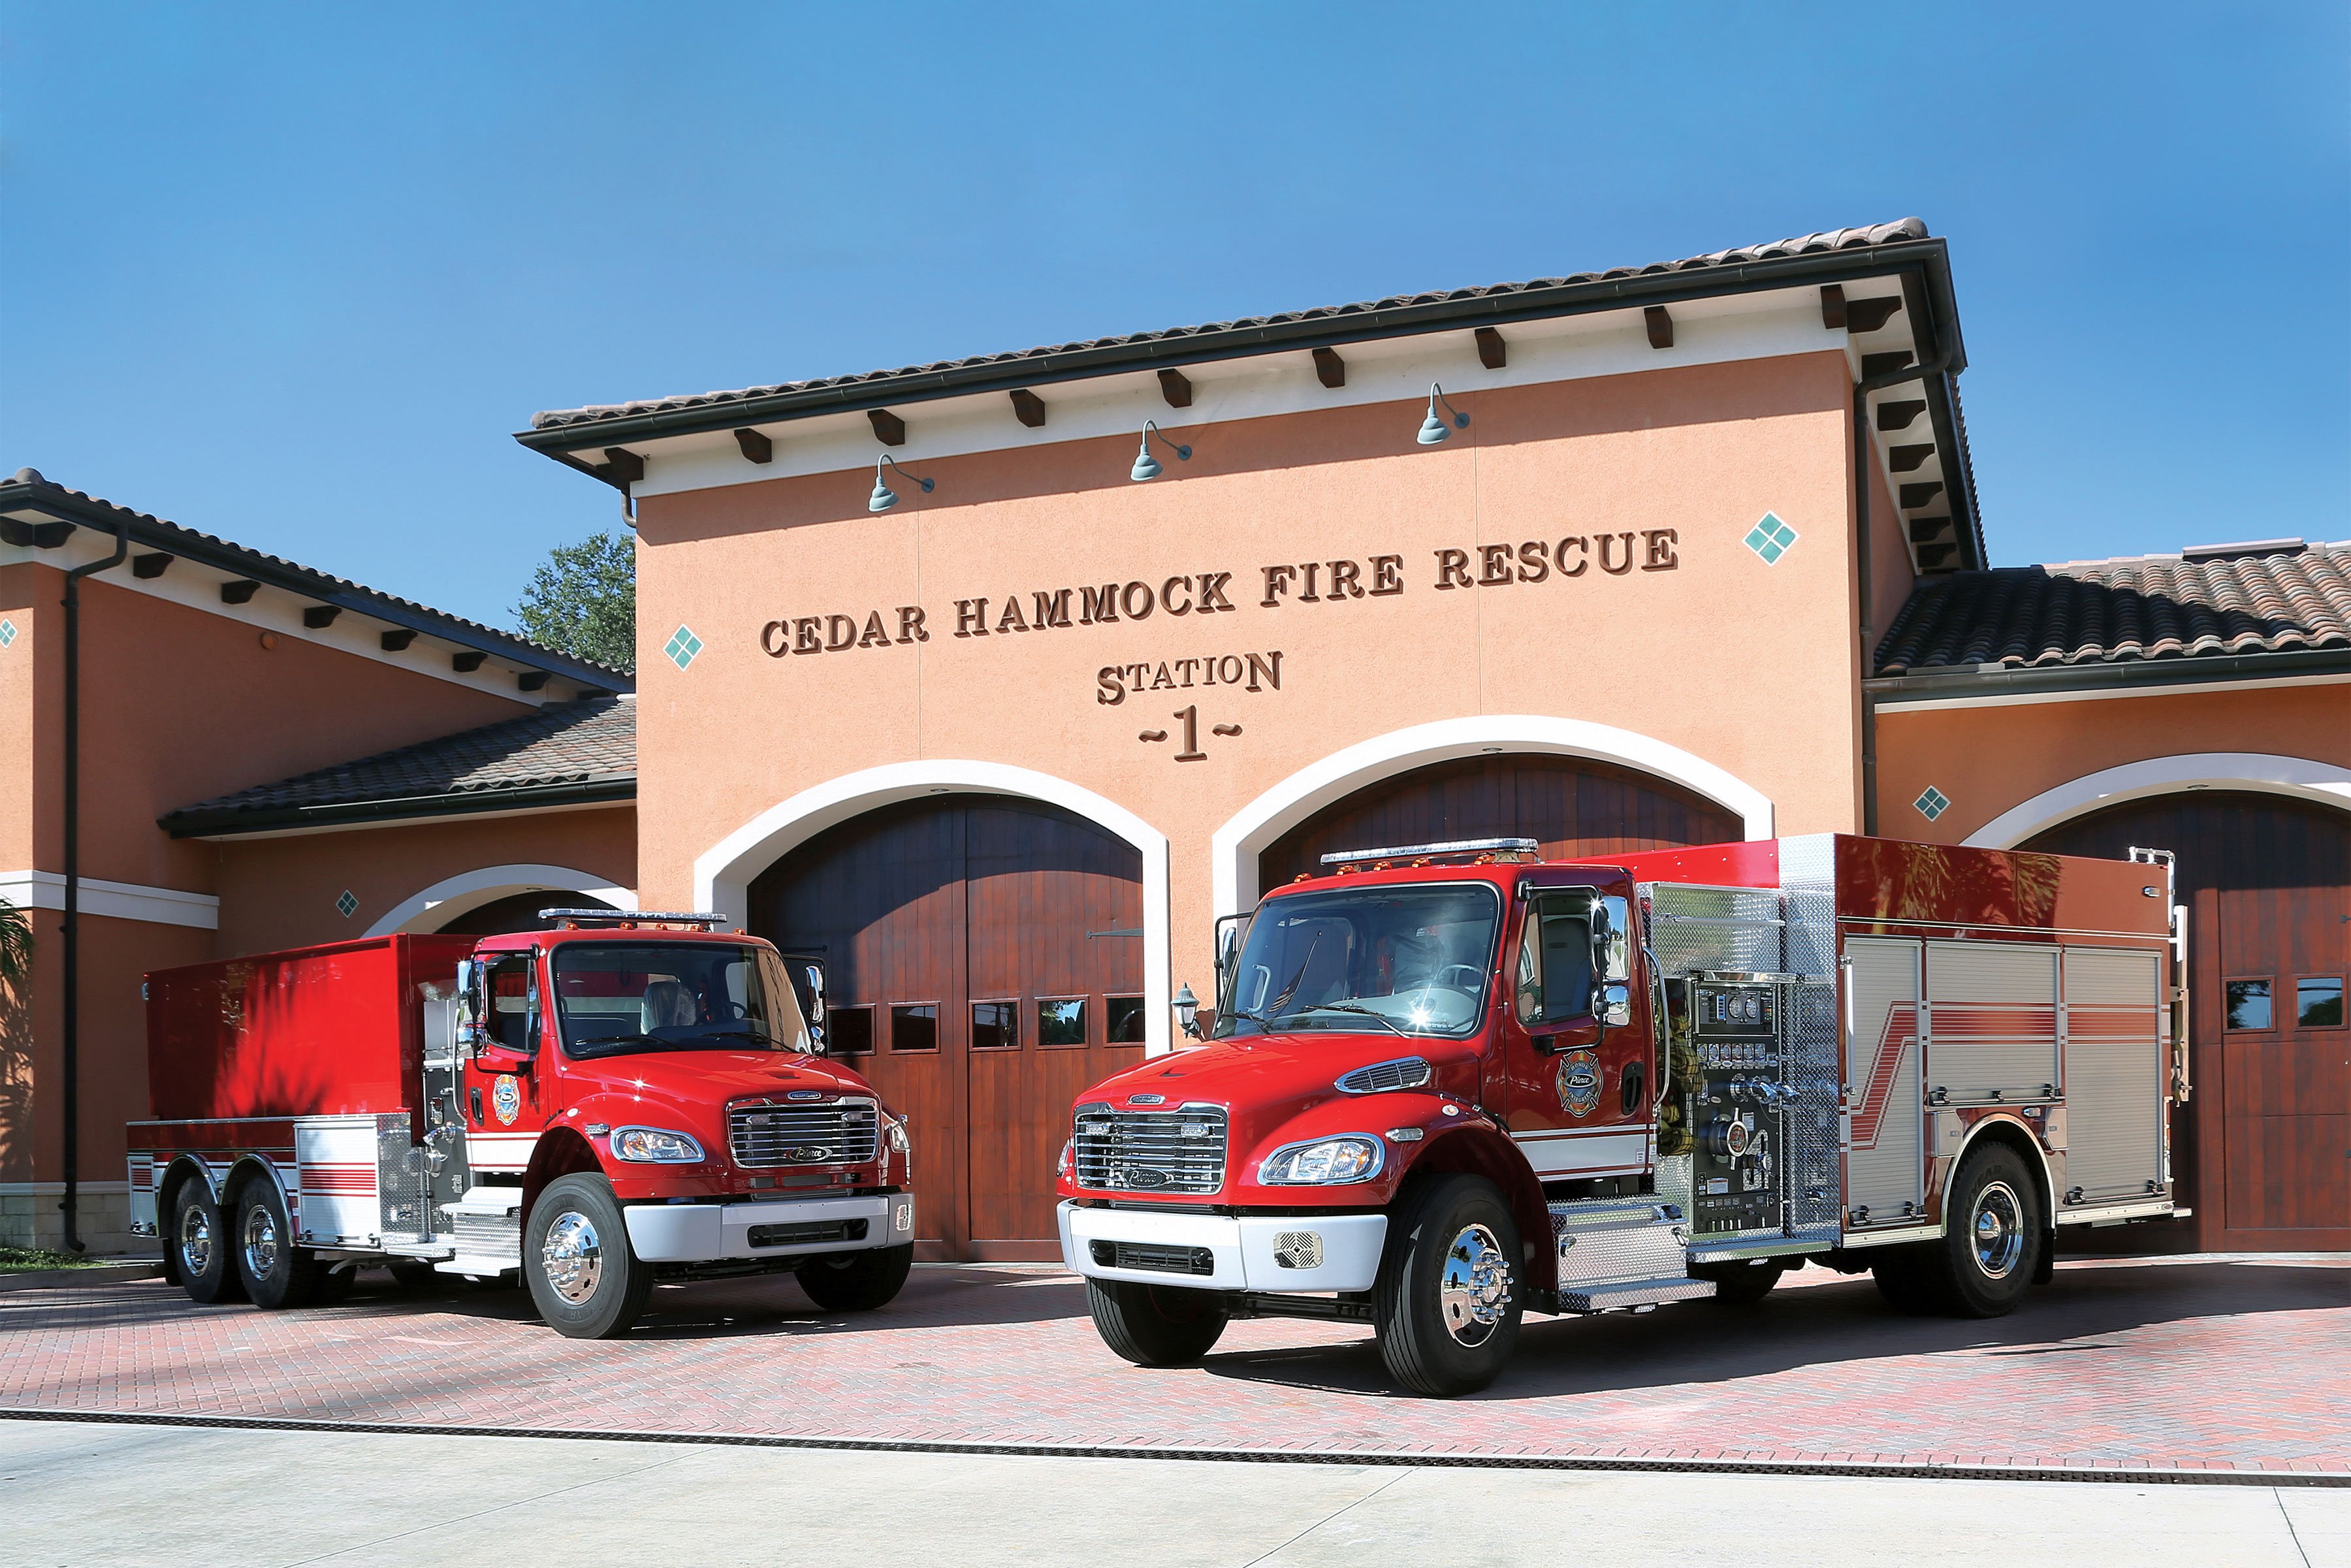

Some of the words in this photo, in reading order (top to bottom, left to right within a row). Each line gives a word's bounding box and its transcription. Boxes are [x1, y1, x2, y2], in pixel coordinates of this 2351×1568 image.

[760, 606, 930, 658] CEDAR
[953, 571, 1236, 639] HAMMOCK
[1260, 554, 1404, 608] FIRE
[1433, 528, 1678, 591] RESCUE
[1570, 1062, 1589, 1071] HONOR
[1569, 1075, 1590, 1085] Pierce
[1569, 1089, 1591, 1102] INTEGRITY
[795, 1148, 822, 1159] Pierce
[1128, 1170, 1157, 1183] Pierce
